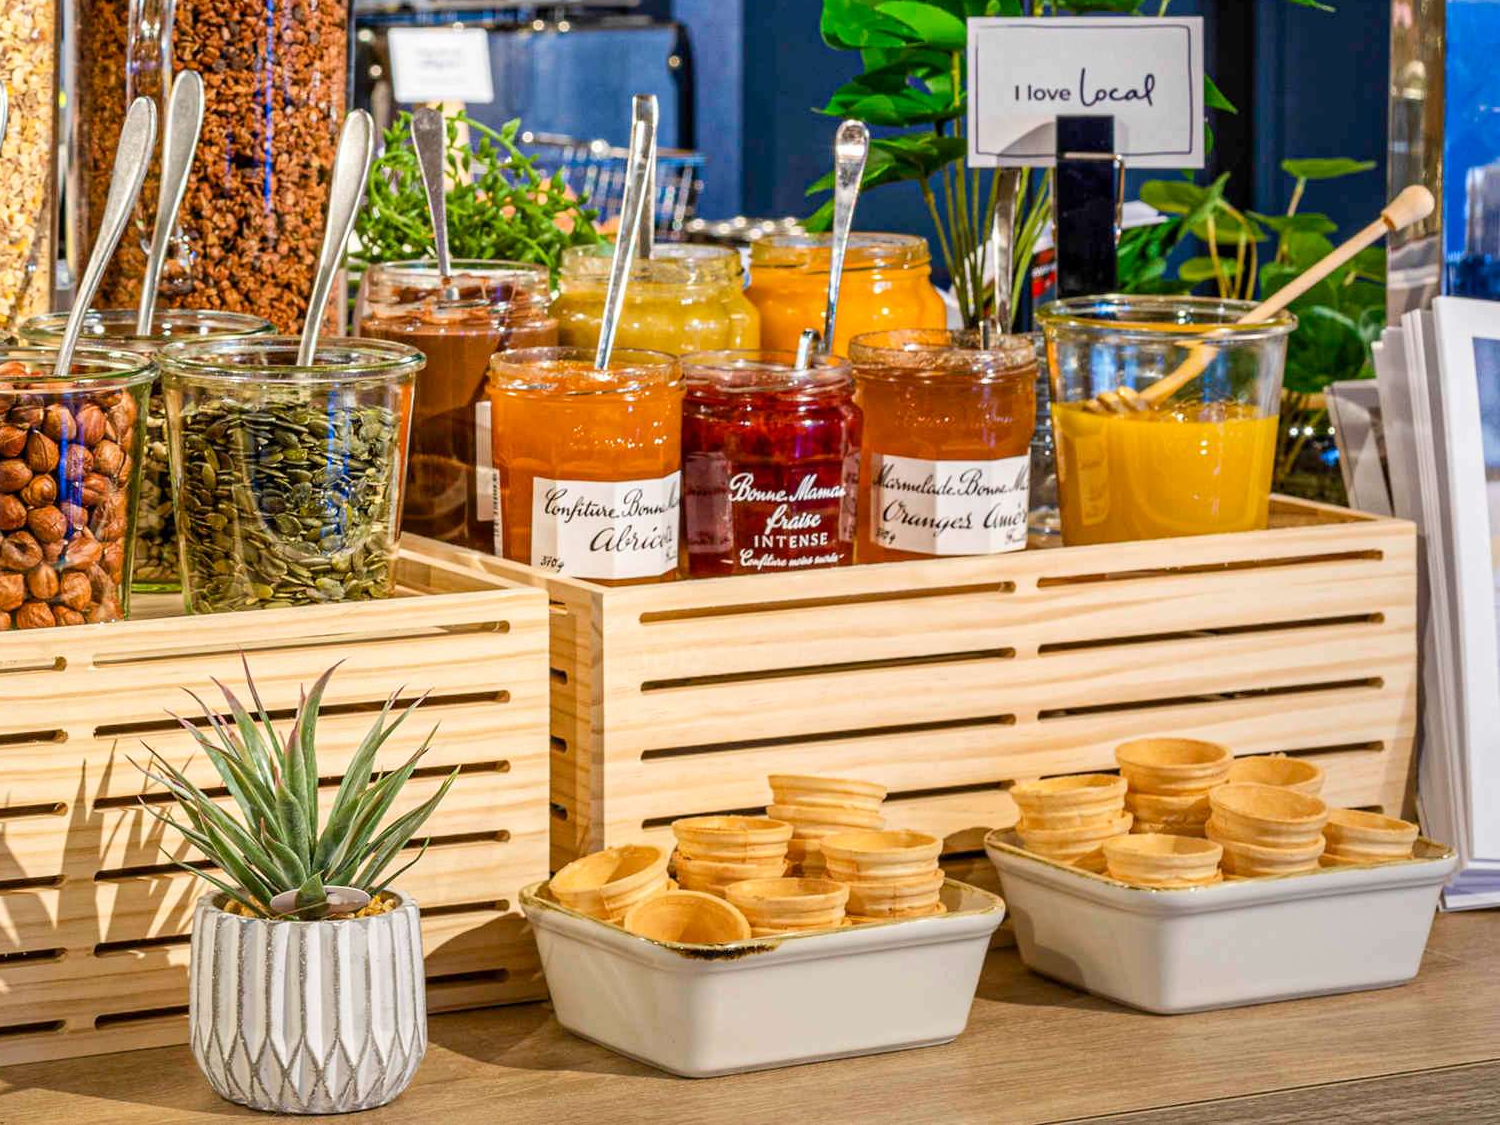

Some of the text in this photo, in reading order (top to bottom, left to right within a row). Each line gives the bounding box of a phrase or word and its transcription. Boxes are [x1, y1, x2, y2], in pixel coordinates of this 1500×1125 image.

[1028, 84, 1071, 101] love
[1080, 67, 1155, 107] Local
[729, 472, 787, 502] Bonne
[873, 463, 955, 495] Marmelade
[956, 468, 1006, 497] Bonne
[544, 488, 619, 523] Confiture
[883, 499, 974, 536] Oranges
[754, 532, 829, 549] INTENSE
